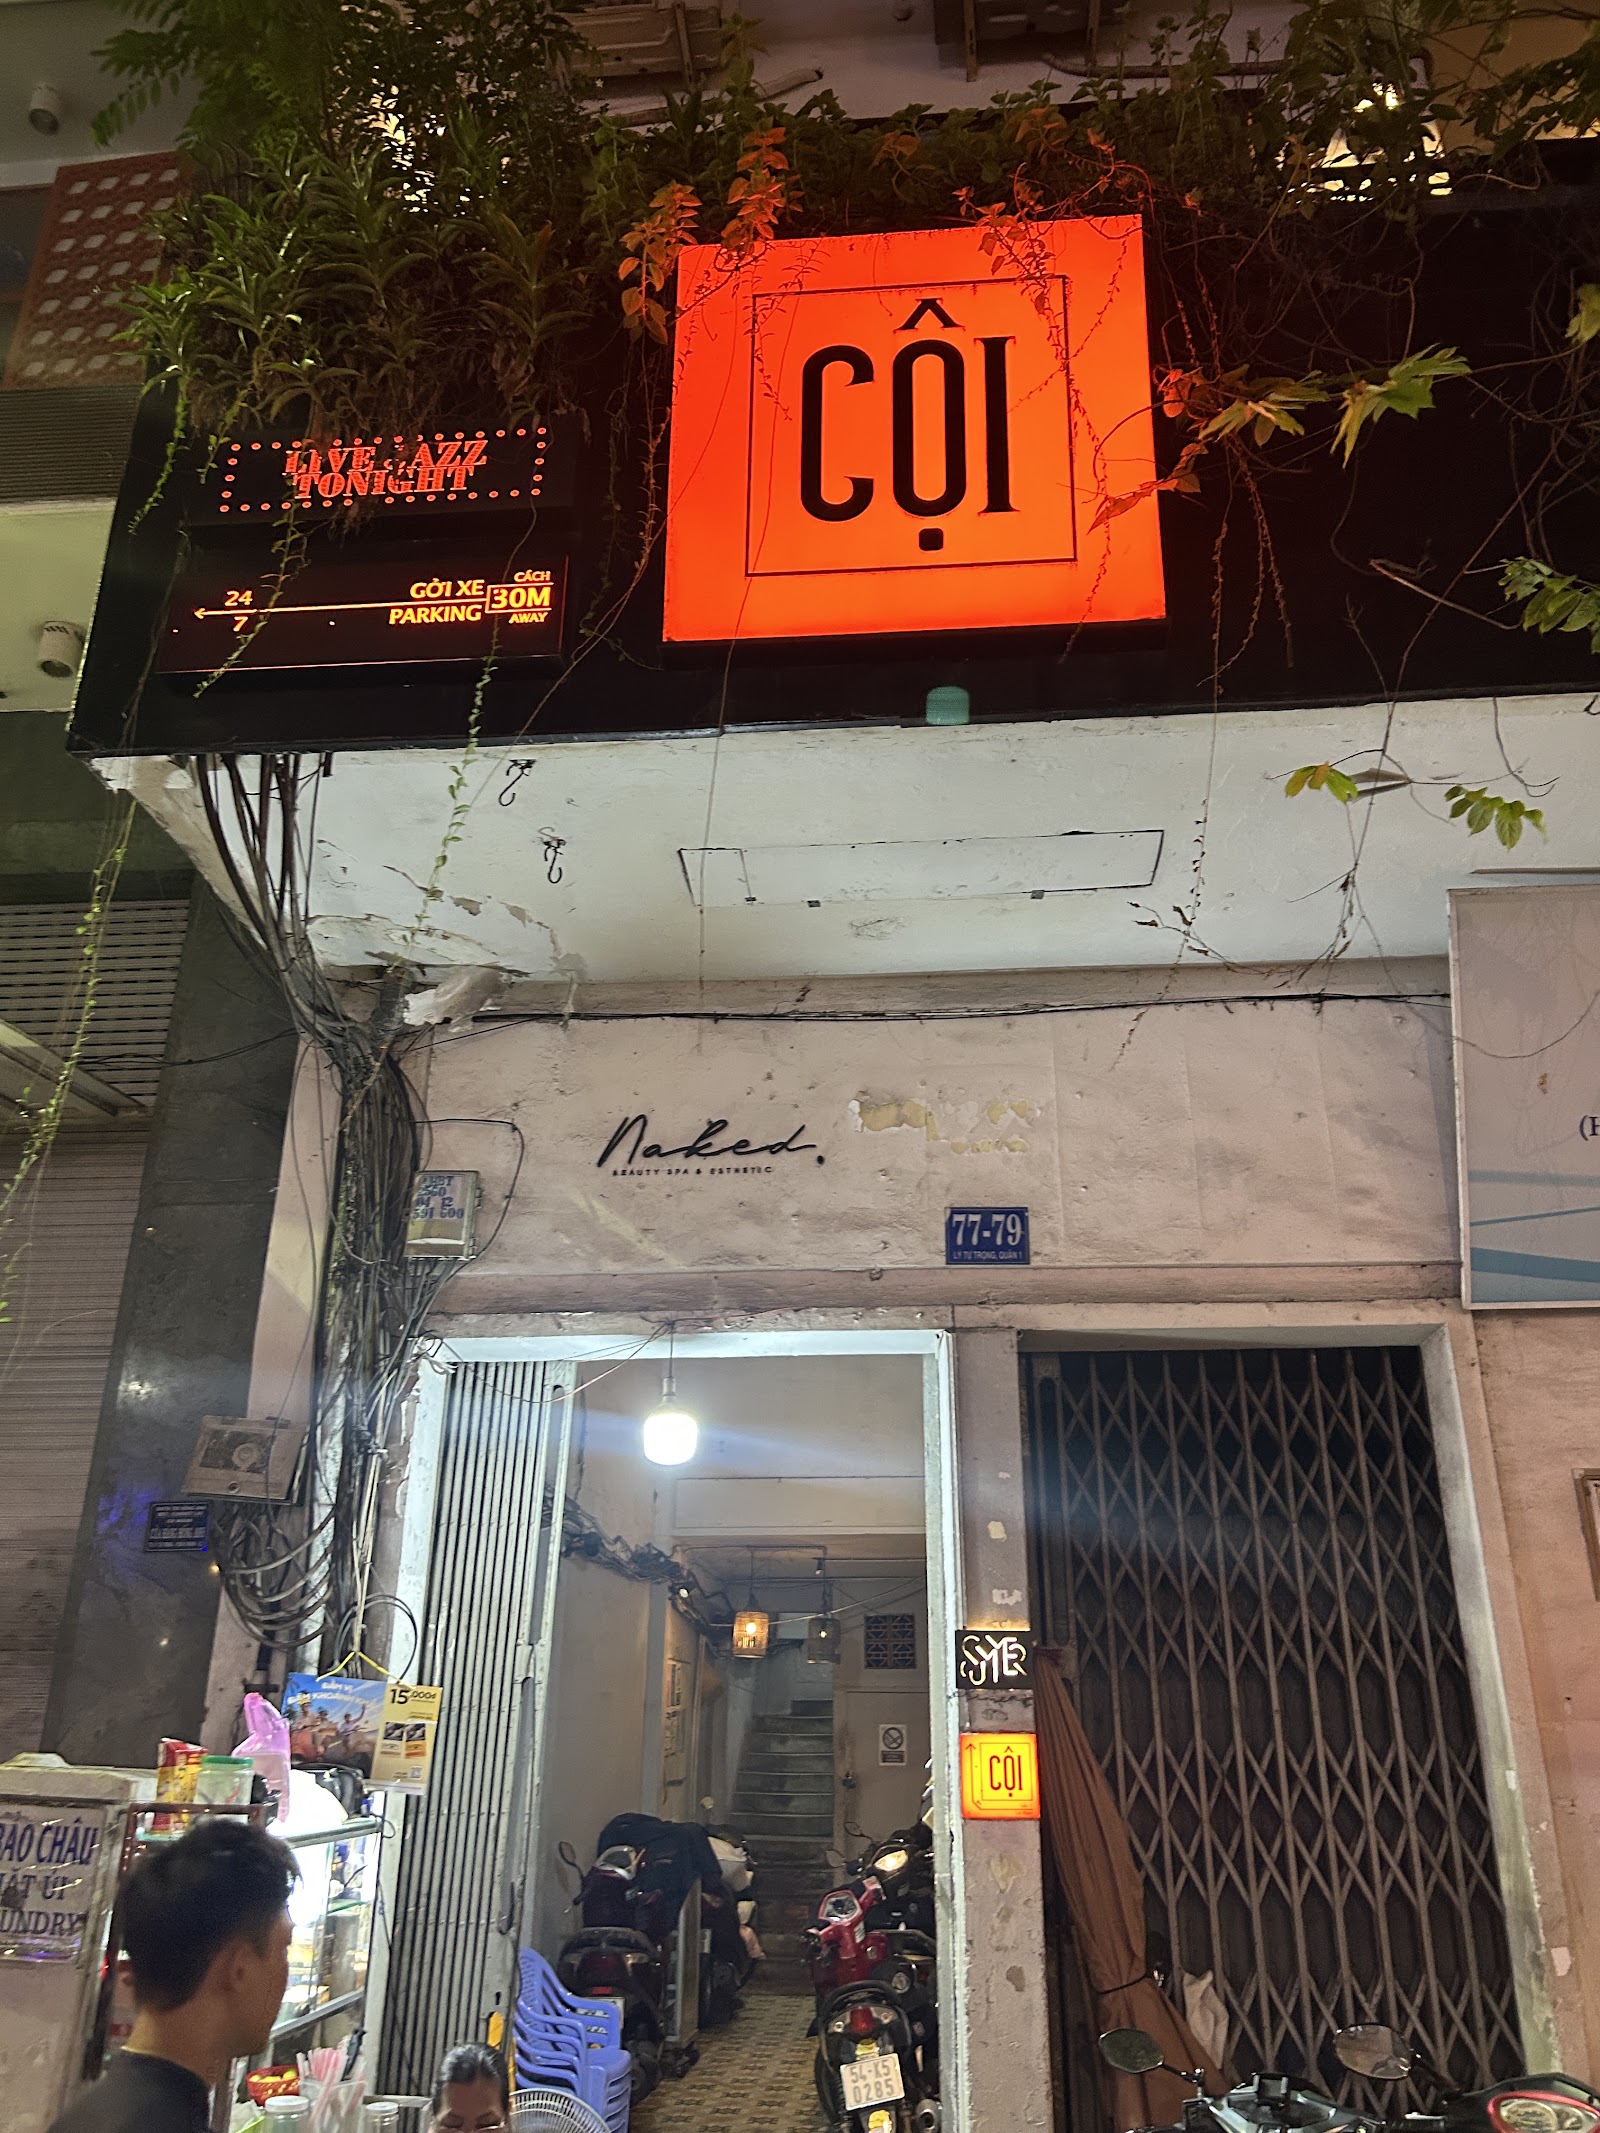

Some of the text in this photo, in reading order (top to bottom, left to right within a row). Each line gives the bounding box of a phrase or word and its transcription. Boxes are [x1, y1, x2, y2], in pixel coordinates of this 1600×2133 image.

[799, 297, 1021, 551] CỘI
[282, 446, 377, 475] LIVE
[292, 465, 475, 499] TONIGHT
[513, 569, 552, 582] CÁCH
[224, 590, 253, 606] 24
[455, 579, 485, 597] XE
[490, 586, 551, 609] 30M
[233, 616, 249, 632] 7
[389, 604, 549, 625] PARKING AWAY
[611, 1168, 661, 1177] BEAUTY
[666, 1168, 689, 1176] SPA
[951, 1213, 1022, 1246] 77-79
[989, 1745, 1024, 1797] CỘI
[849, 2058, 891, 2084] 54-K5
[852, 2078, 895, 2105] 0285
